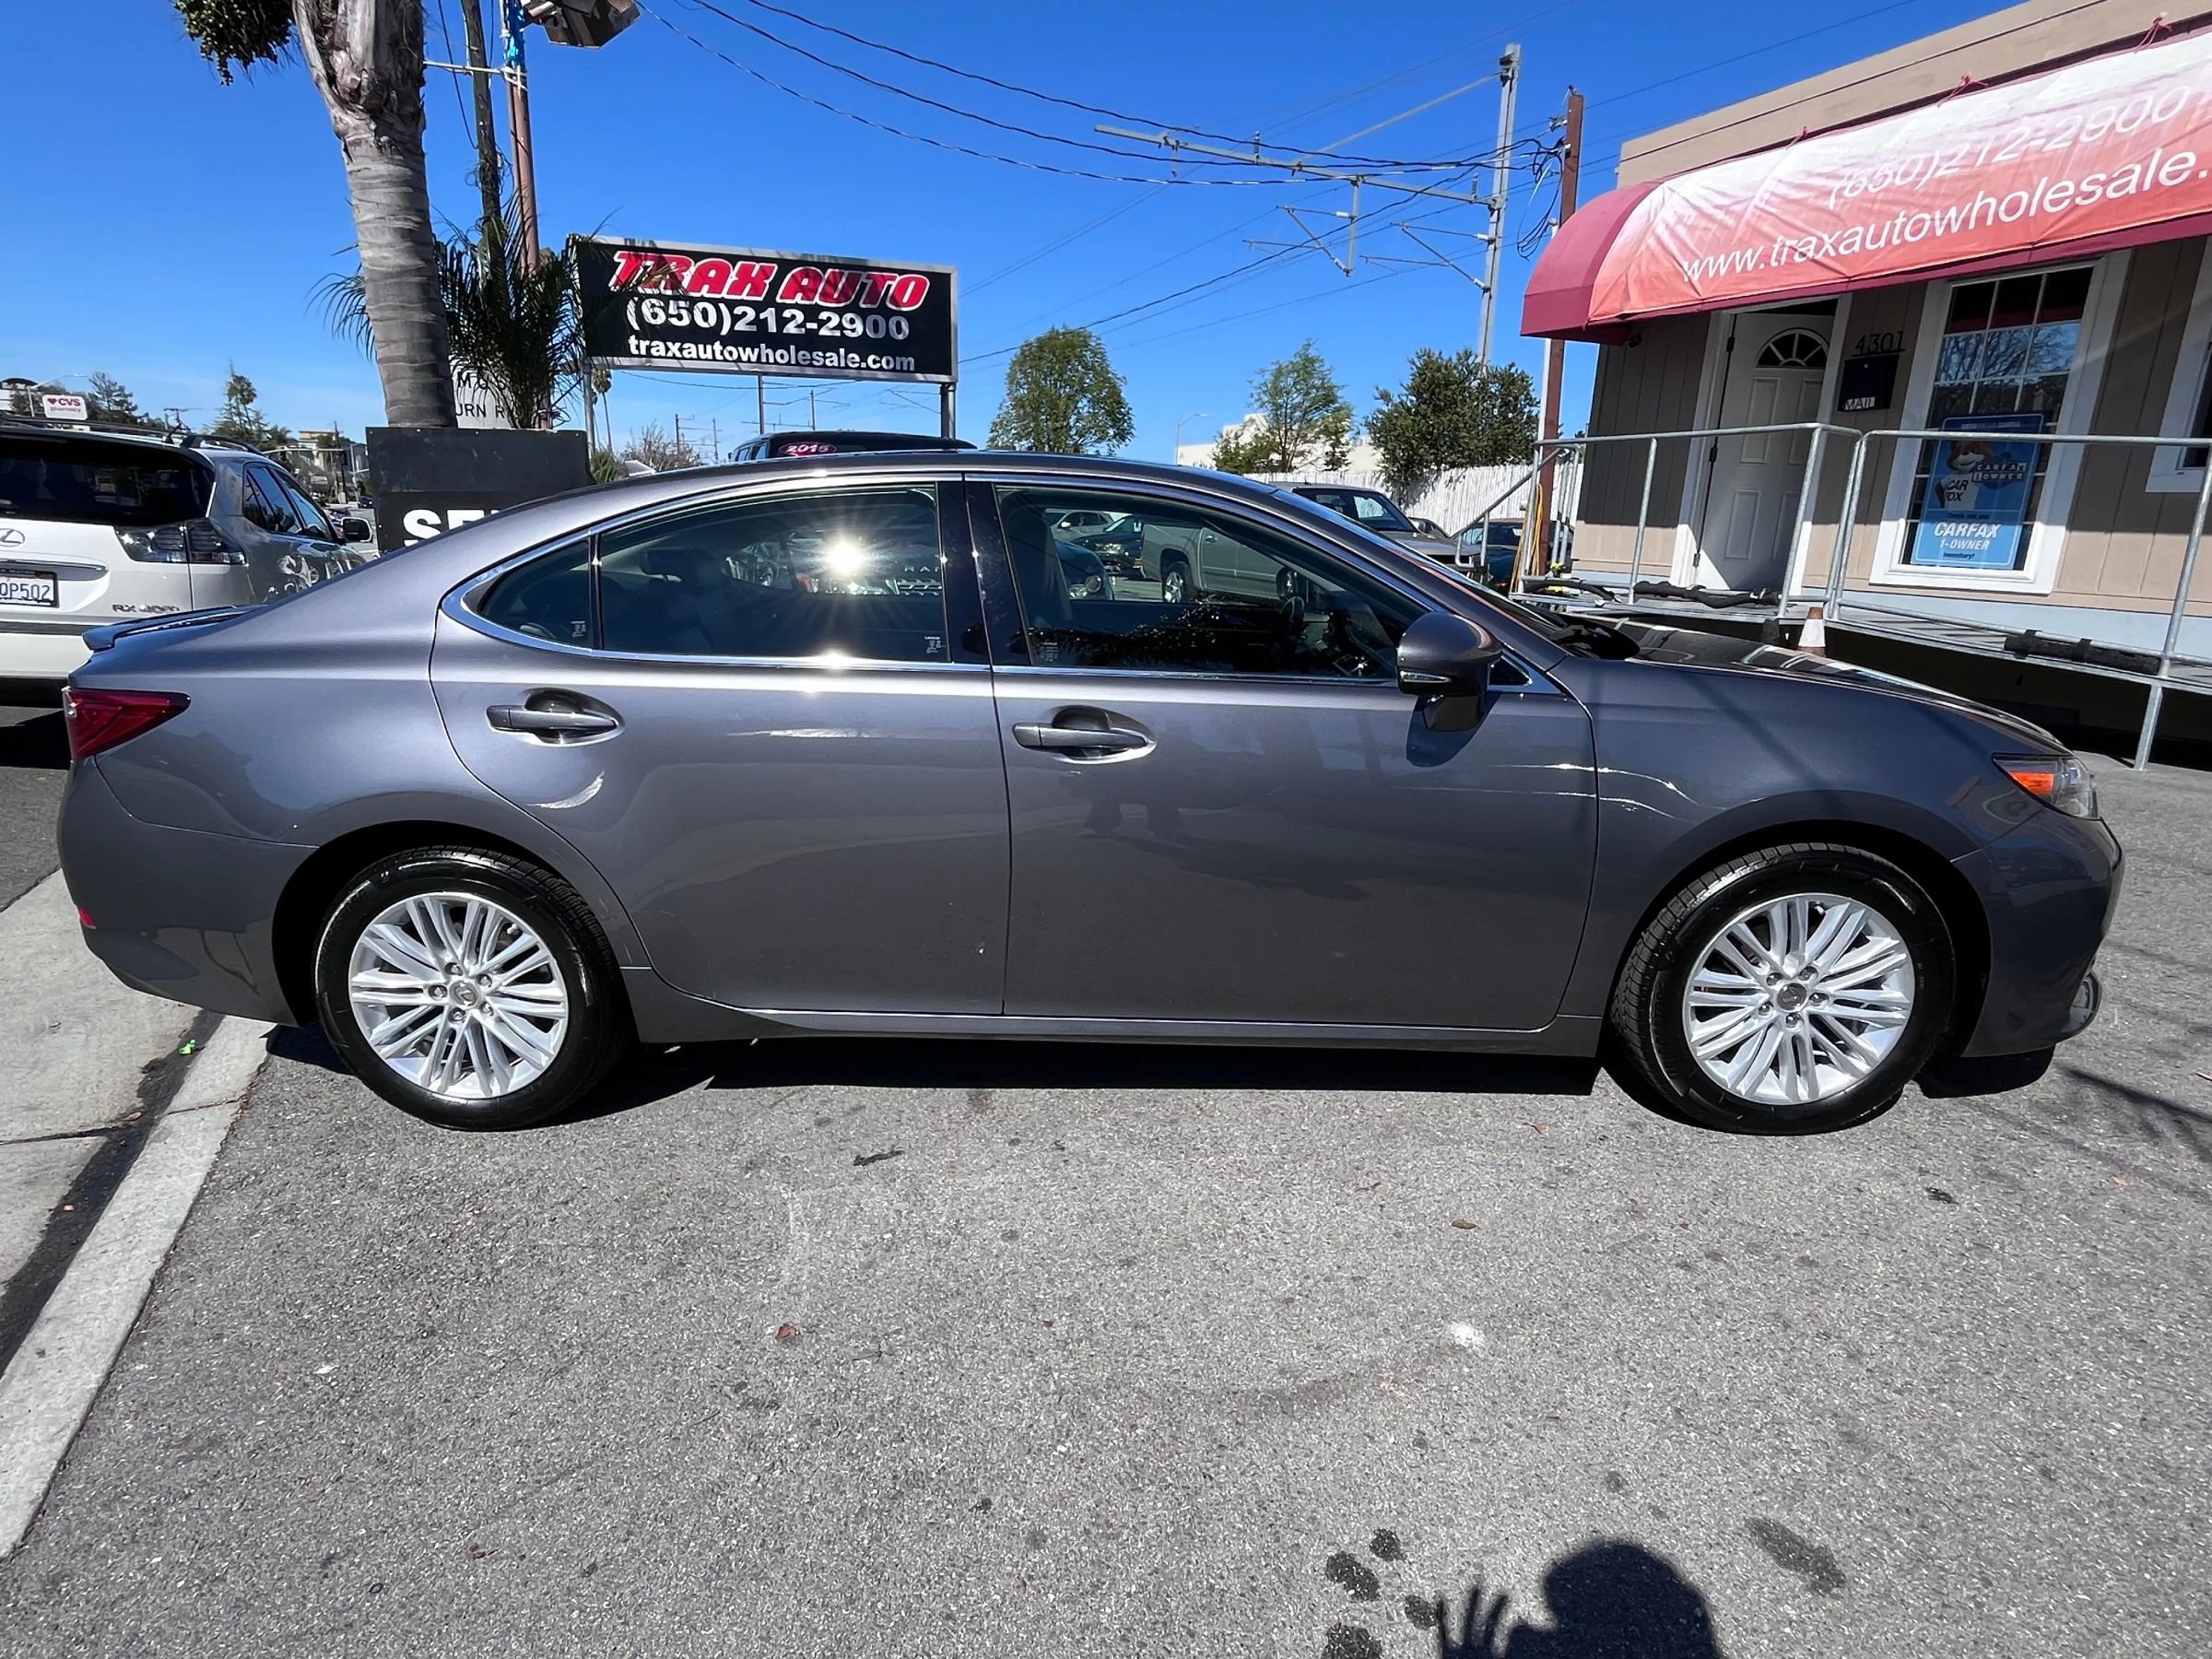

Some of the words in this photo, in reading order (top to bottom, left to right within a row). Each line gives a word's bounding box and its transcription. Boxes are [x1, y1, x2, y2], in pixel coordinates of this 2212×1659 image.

[1829, 86, 2192, 211] (650)212-2900
[1682, 147, 2208, 282] www.traxautowholesale.
[608, 250, 778, 301] TRAX
[775, 265, 930, 312] AUTO
[626, 296, 910, 341] (650)212-2900
[628, 334, 915, 371] traxautowholesale.com
[1853, 330, 1907, 357] 4301
[58, 397, 81, 406] CVS
[1934, 522, 2002, 538] CARFAX
[1939, 538, 1991, 550] 1-OWNER
[112, 604, 137, 613] RX
